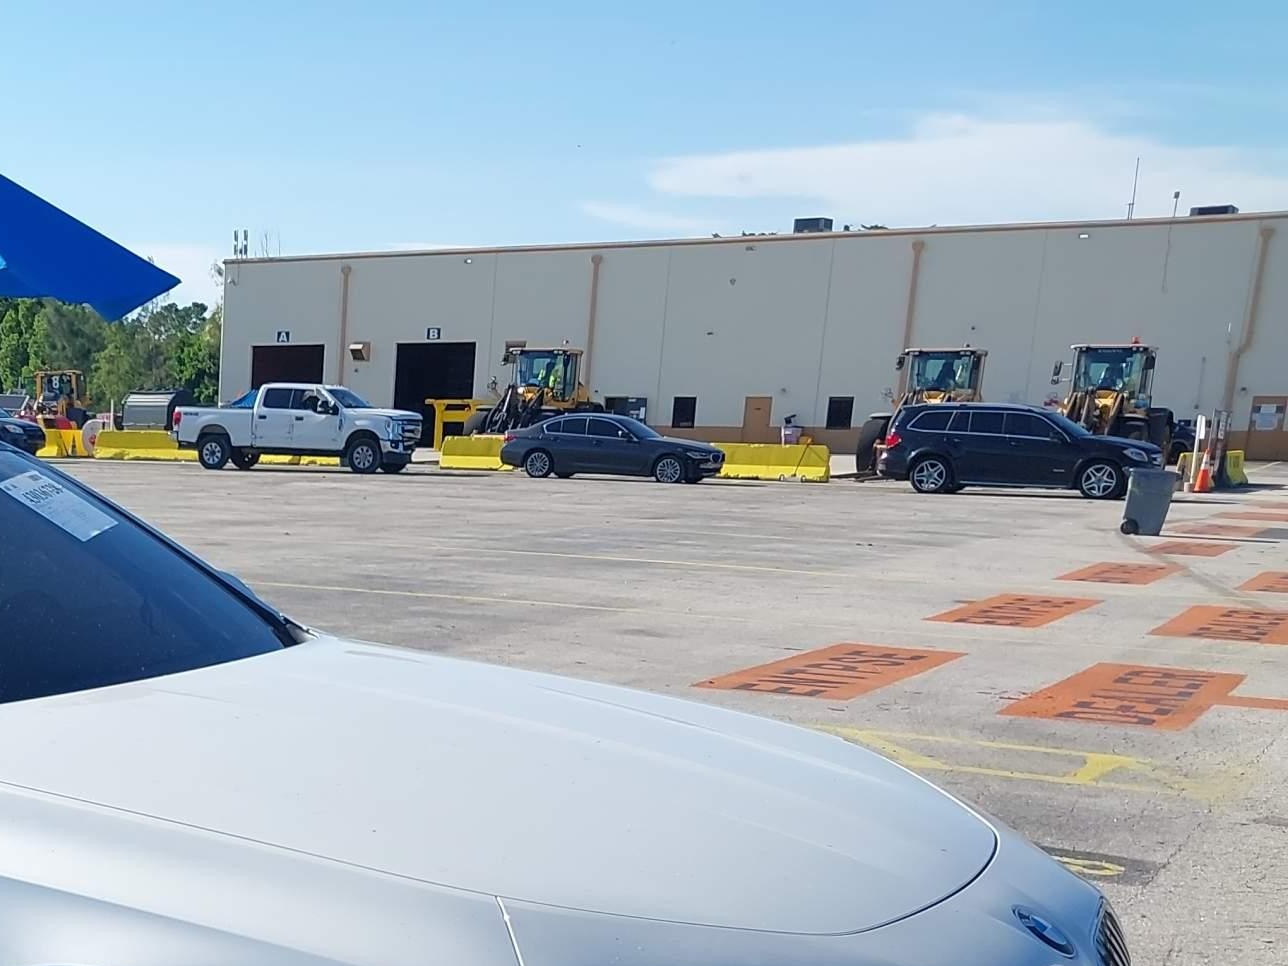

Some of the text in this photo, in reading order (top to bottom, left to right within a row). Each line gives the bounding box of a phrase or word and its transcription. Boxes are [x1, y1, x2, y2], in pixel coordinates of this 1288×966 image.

[278, 332, 288, 343] A
[429, 329, 439, 339] B
[52, 375, 60, 389] 8
[1054, 669, 1217, 726] DEALER
